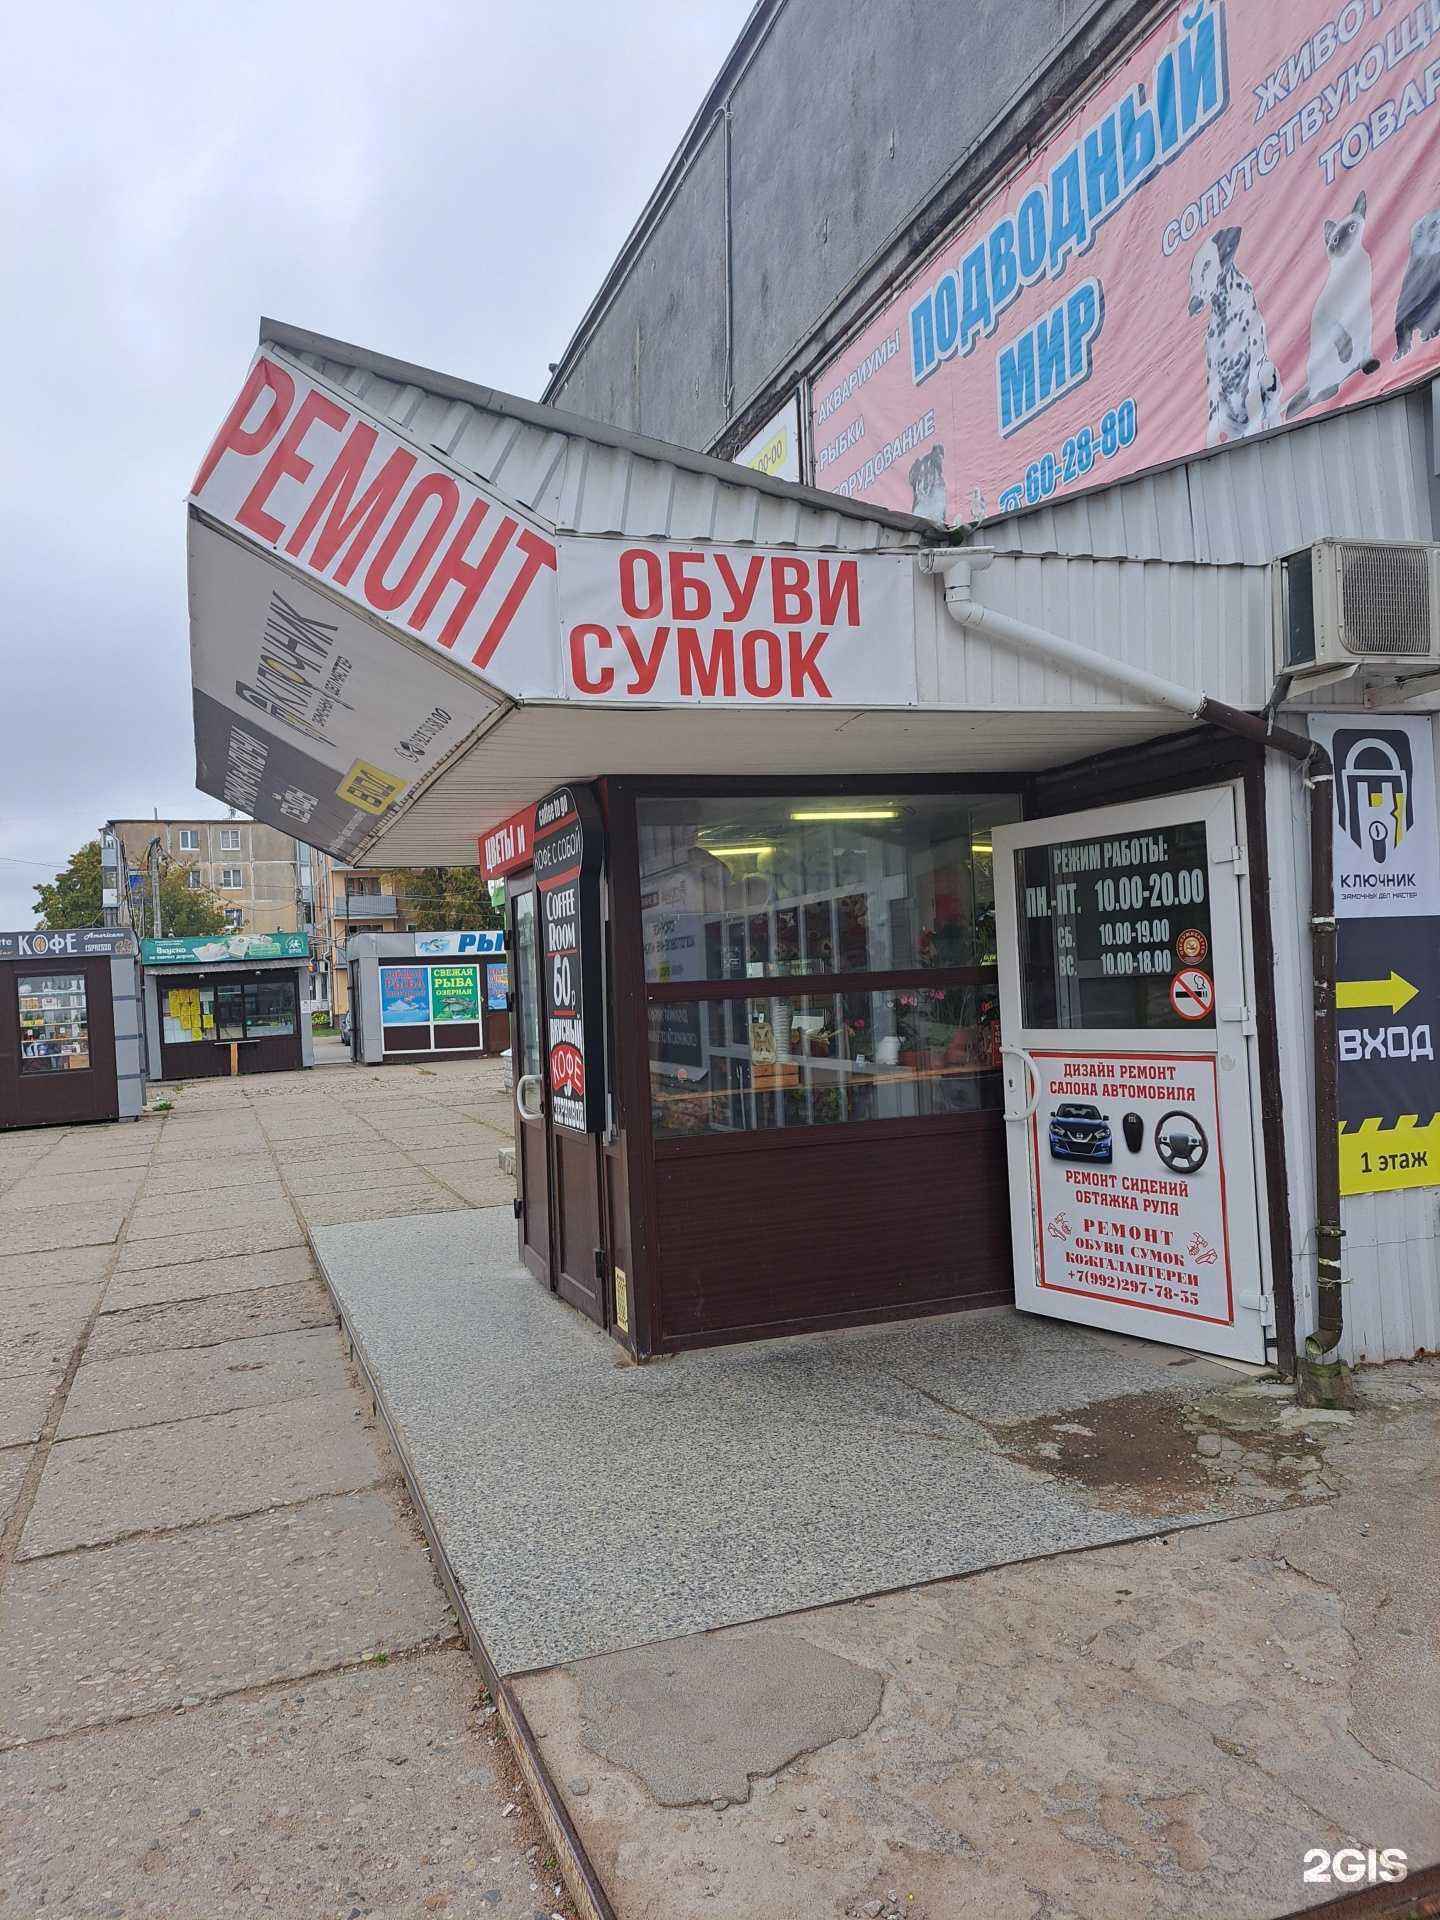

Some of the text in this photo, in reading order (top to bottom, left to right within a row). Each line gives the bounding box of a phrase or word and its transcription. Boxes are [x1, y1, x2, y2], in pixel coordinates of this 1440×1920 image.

[909, 0, 1226, 381] ПОДВОДНЫЙ
[998, 278, 1103, 434] МИР
[817, 330, 900, 426] АКВАРИУМЫ
[818, 414, 866, 473] РЫБКИ
[1024, 398, 1137, 504] 60-28-80
[190, 354, 558, 671] РЕМОНТ
[618, 548, 861, 627] ОБУВИ
[568, 622, 833, 699] СУМОК
[484, 824, 514, 873] ЦВЕТЫ
[557, 826, 581, 863] СОБОЙ
[1053, 834, 1169, 874] РЕЖИМ РАБОТЫ:
[1025, 868, 1206, 918] ПН.-ПТ. 10.00-20.00
[1340, 873, 1416, 888] КЛЮЧНИК
[18, 933, 77, 955] КОФЕ
[549, 922, 575, 952] ROOM
[1057, 919, 1171, 949] СБ. 10.00-19.00
[433, 968, 473, 977] СВЕЖАЯ
[1058, 949, 1172, 977] ВС. 10.00-18.00
[1338, 1024, 1434, 1062] ВХОД
[552, 1051, 582, 1088] КОФЕ
[1063, 1063, 1176, 1081] ДИЗАЙН РЕМОНТ
[1050, 1081, 1196, 1101] САЛОНА АВТОМОБИЛЯ
[1361, 1150, 1428, 1174] 1 этаж
[1065, 1170, 1189, 1198] РЕМОНТ СИДЕНИЙ
[1075, 1190, 1179, 1216] ОБТЯЖКА РУЛЯ
[1083, 1219, 1173, 1246] РЕМОНТ
[1075, 1237, 1185, 1267] ОБУВИ СУМОК
